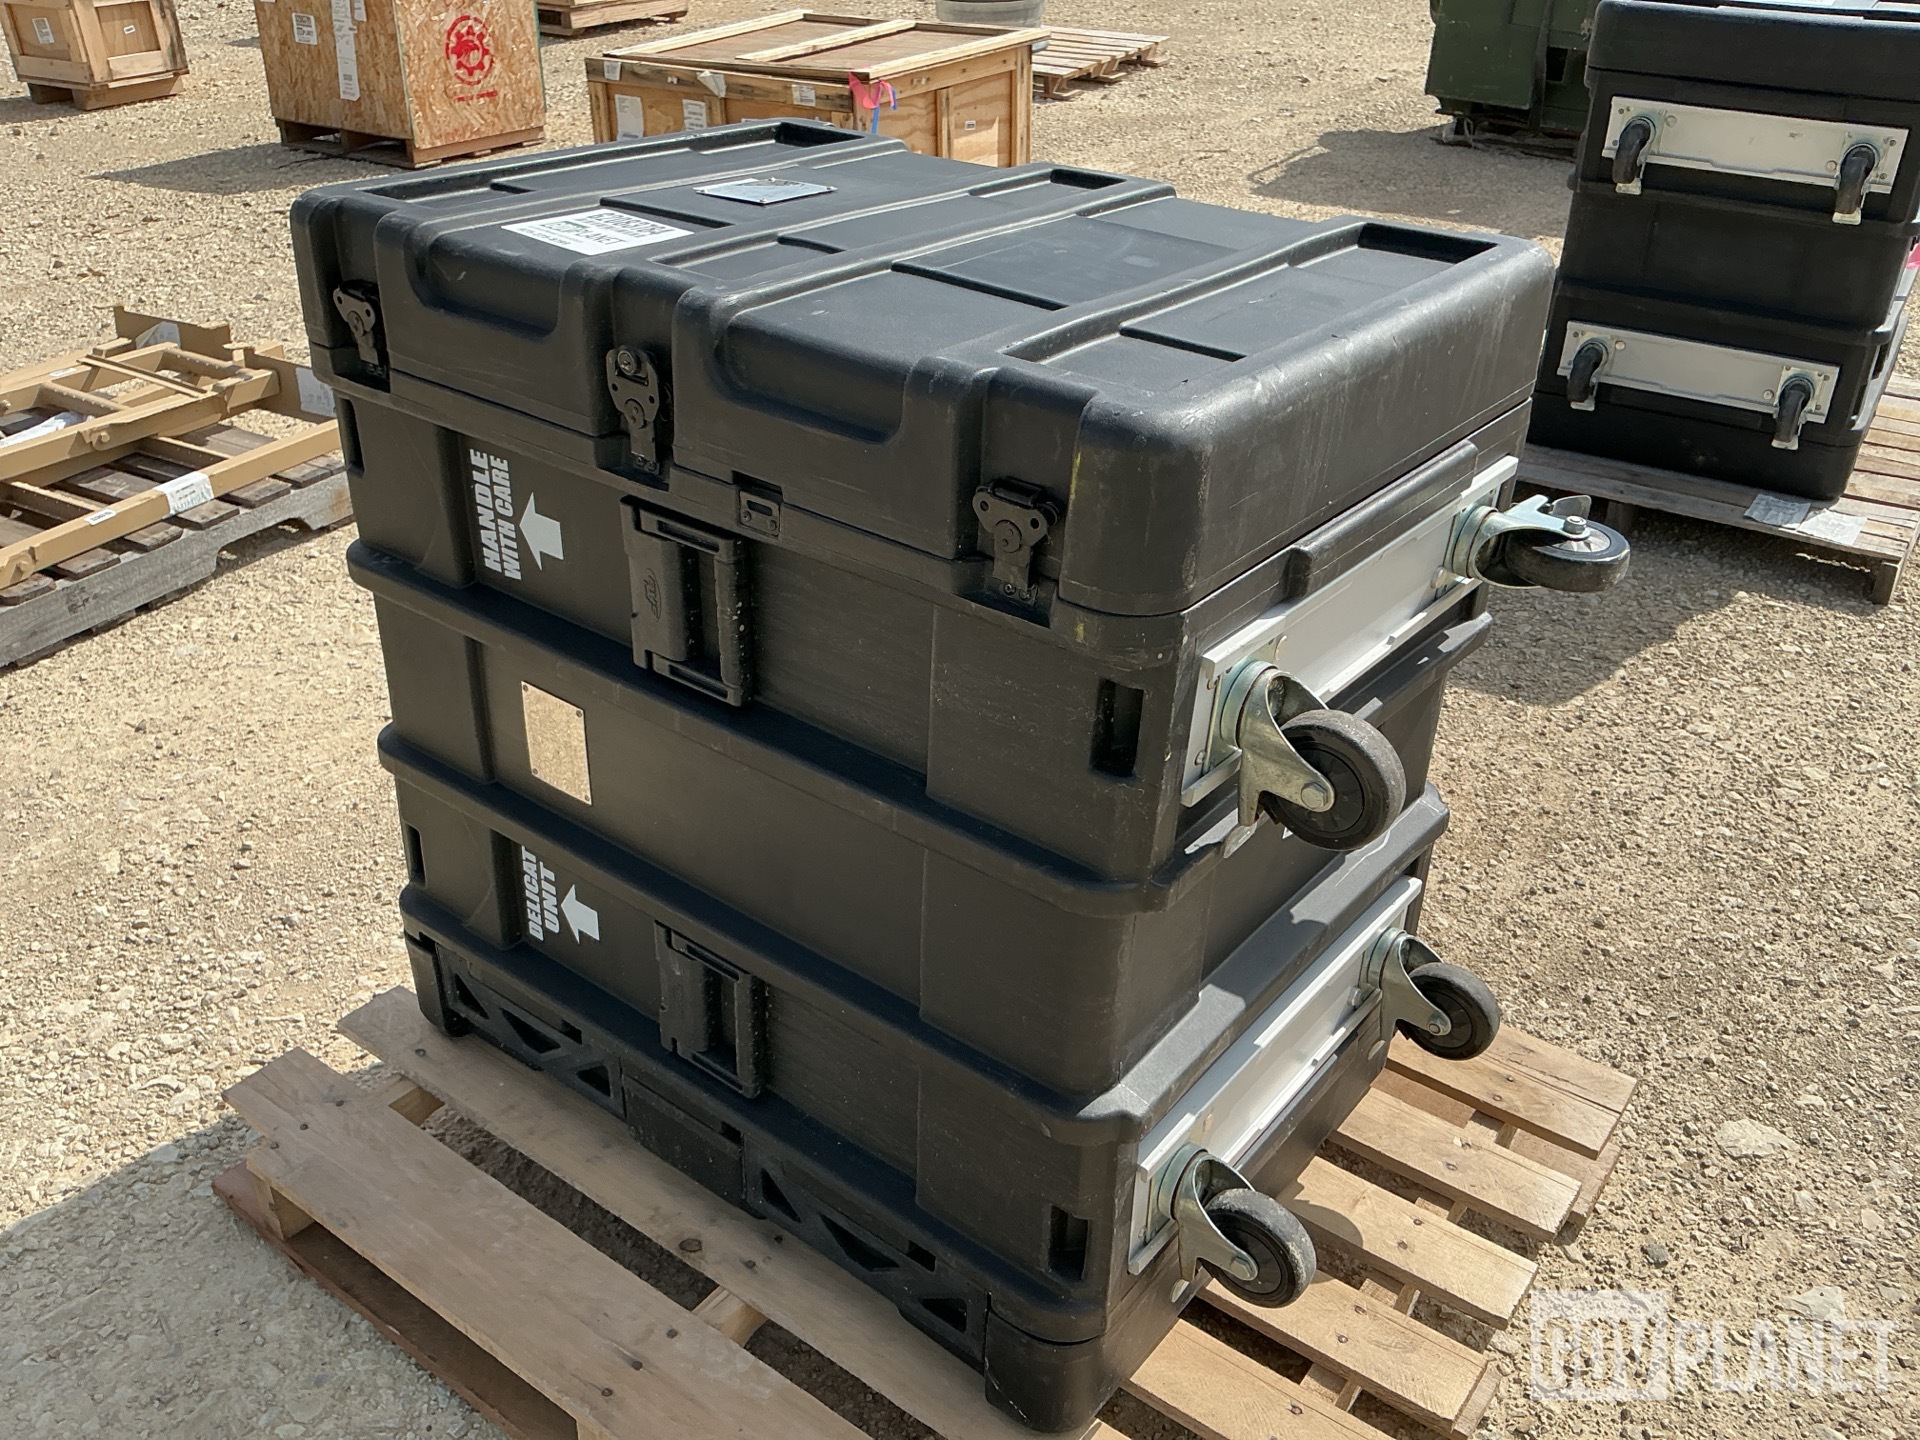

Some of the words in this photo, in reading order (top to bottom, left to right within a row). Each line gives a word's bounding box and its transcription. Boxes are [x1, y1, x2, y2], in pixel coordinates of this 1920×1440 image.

[469, 448, 502, 573] HANDLE
[490, 454, 514, 517] CARE
[497, 519, 522, 580] WITH
[521, 845, 544, 942] DELICAT
[539, 860, 560, 934] UNIT
